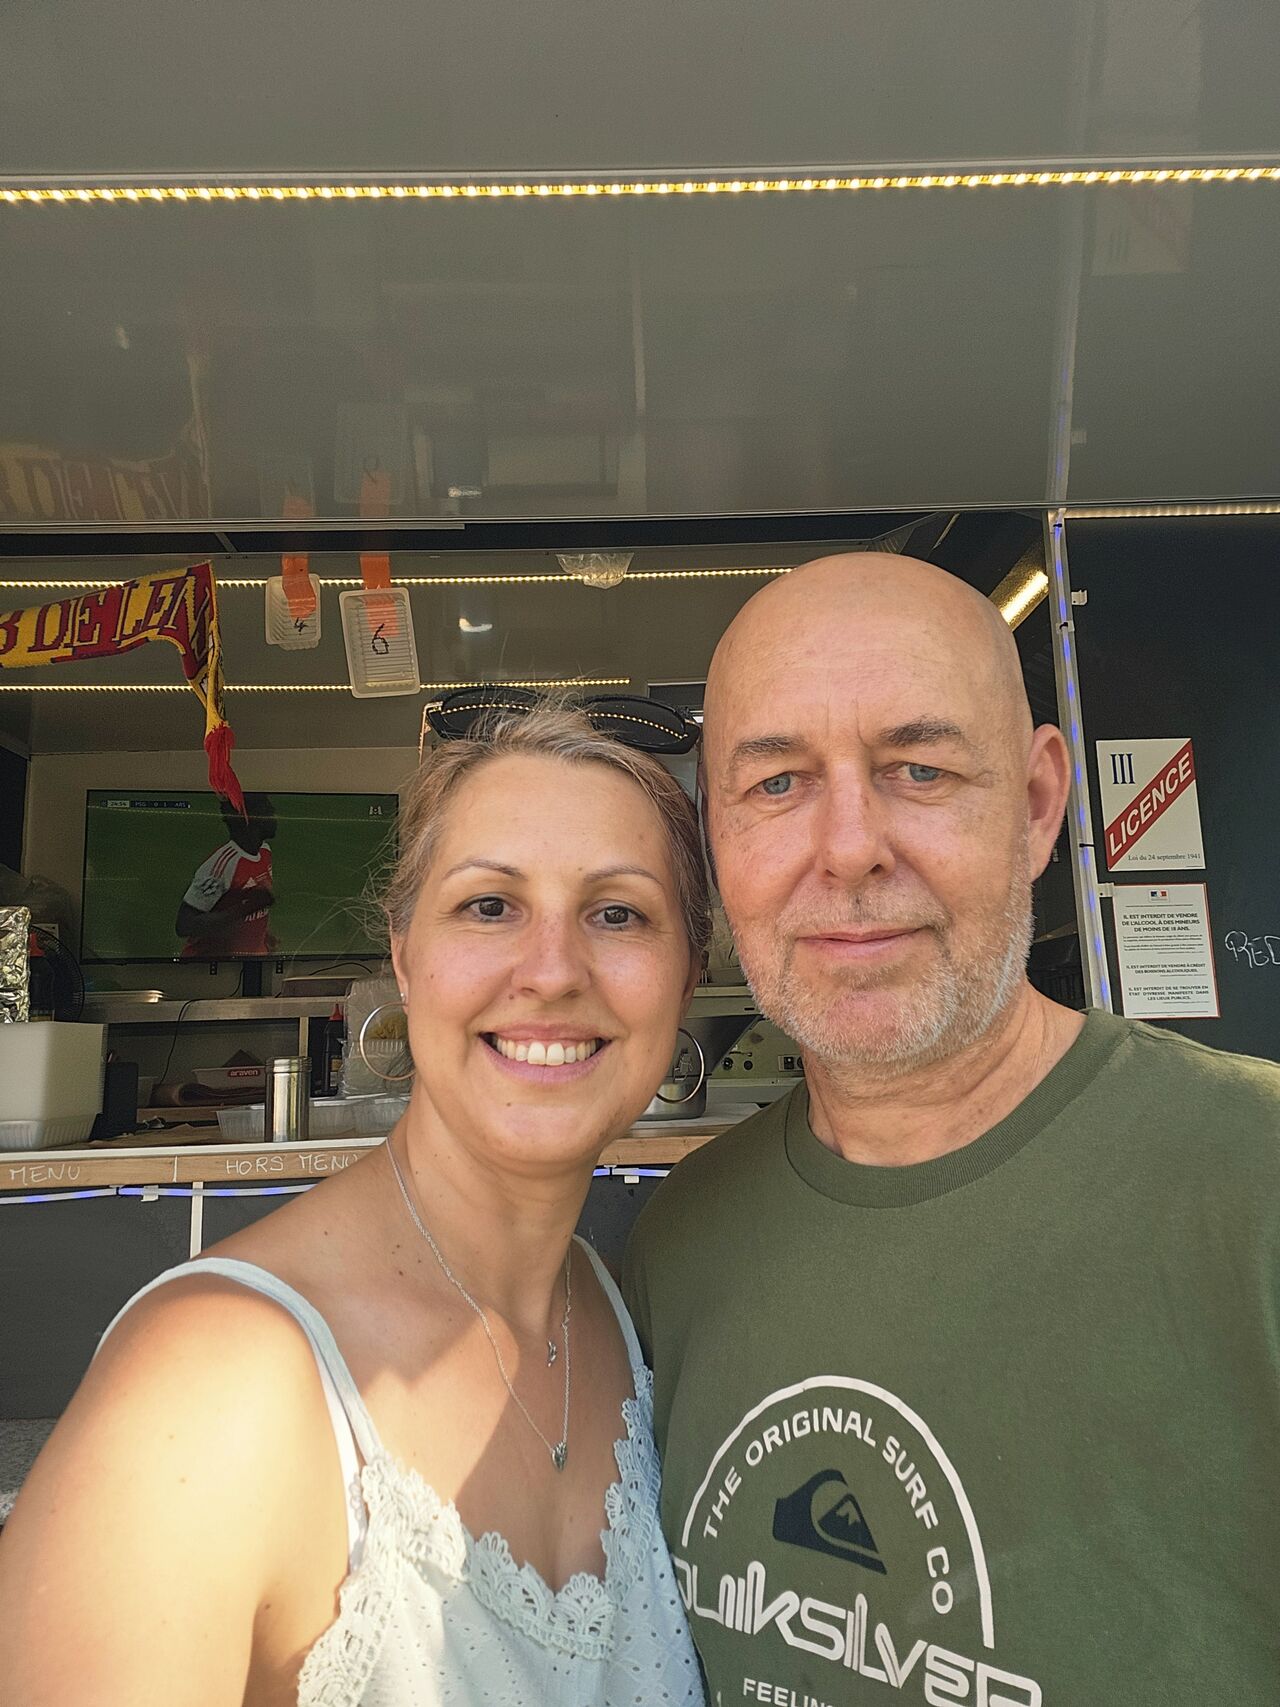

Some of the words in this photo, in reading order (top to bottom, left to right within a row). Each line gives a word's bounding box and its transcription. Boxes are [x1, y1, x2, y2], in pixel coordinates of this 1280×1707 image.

[372, 623, 390, 655] 6
[1110, 753, 1135, 785] III
[1109, 752, 1192, 857] LICENCE
[1157, 853, 1186, 861] septembre
[9, 1163, 80, 1186] MENU
[226, 1155, 284, 1175] HORS
[703, 1466, 742, 1539] THE
[745, 1407, 878, 1467] ORIGINAL
[882, 1435, 939, 1529] SURF
[926, 1545, 954, 1615] CO
[742, 1677, 834, 1707] FEELIN
